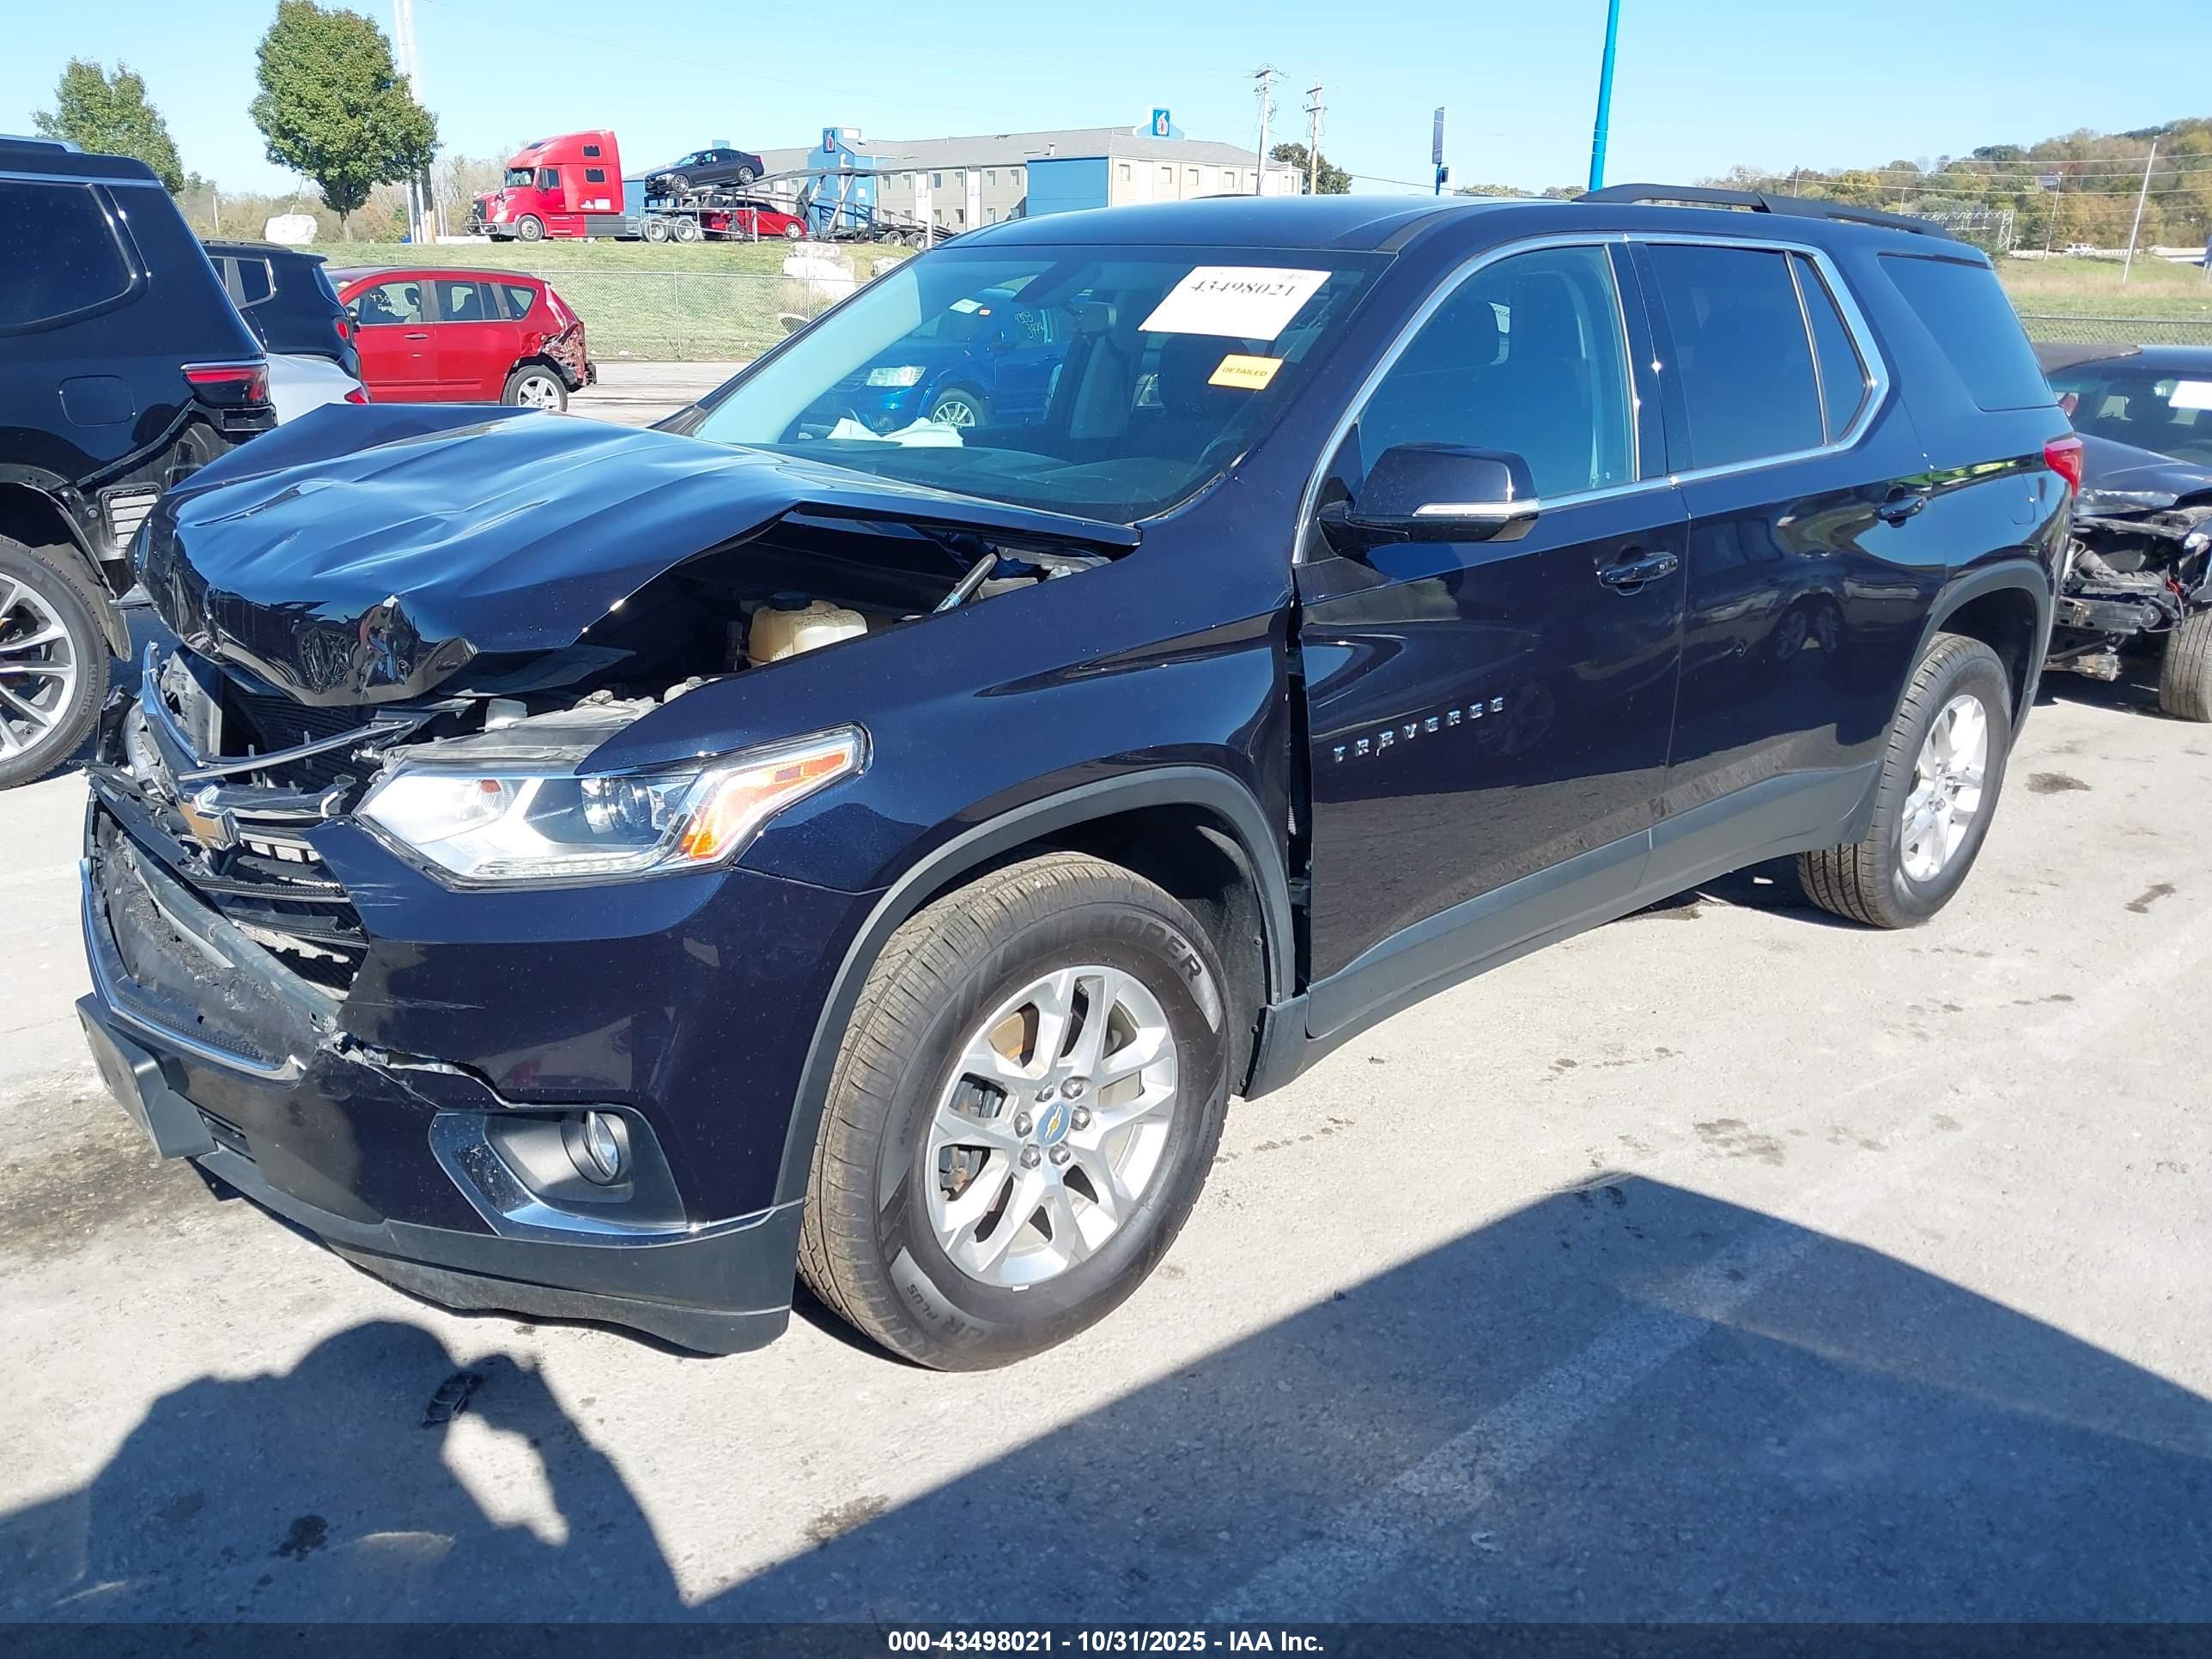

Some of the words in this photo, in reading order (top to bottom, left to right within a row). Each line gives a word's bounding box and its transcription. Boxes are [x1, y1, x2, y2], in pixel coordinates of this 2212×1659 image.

[1157, 112, 1169, 135] 6
[369, 293, 392, 303] 435
[1190, 279, 1297, 297] 43498021
[1221, 366, 1267, 378] DETAILED
[80, 663, 98, 716] KUMHO
[1333, 696, 1504, 763] TRAVERSE
[907, 1284, 939, 1321] PLUS
